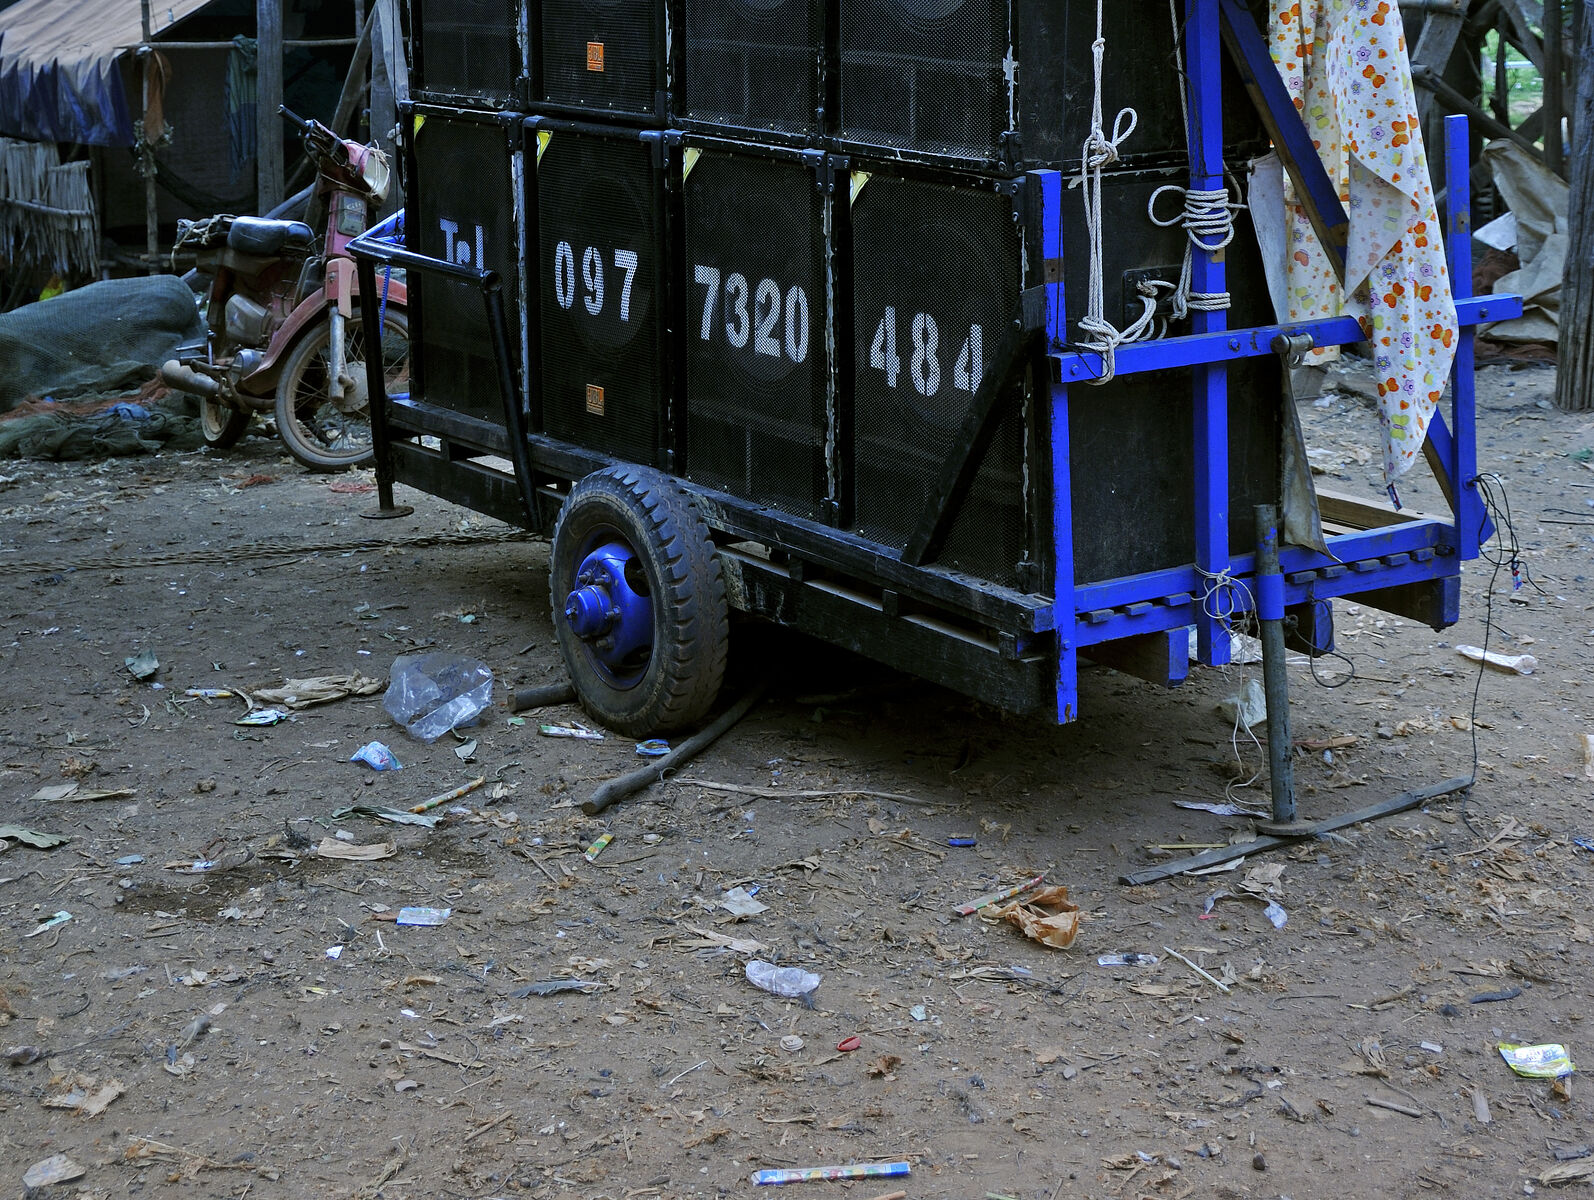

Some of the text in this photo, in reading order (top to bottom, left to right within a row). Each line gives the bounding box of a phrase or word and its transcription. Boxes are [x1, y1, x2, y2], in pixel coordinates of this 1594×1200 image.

[554, 241, 638, 322] 097
[694, 265, 810, 364] 7320
[869, 306, 983, 397] 484
